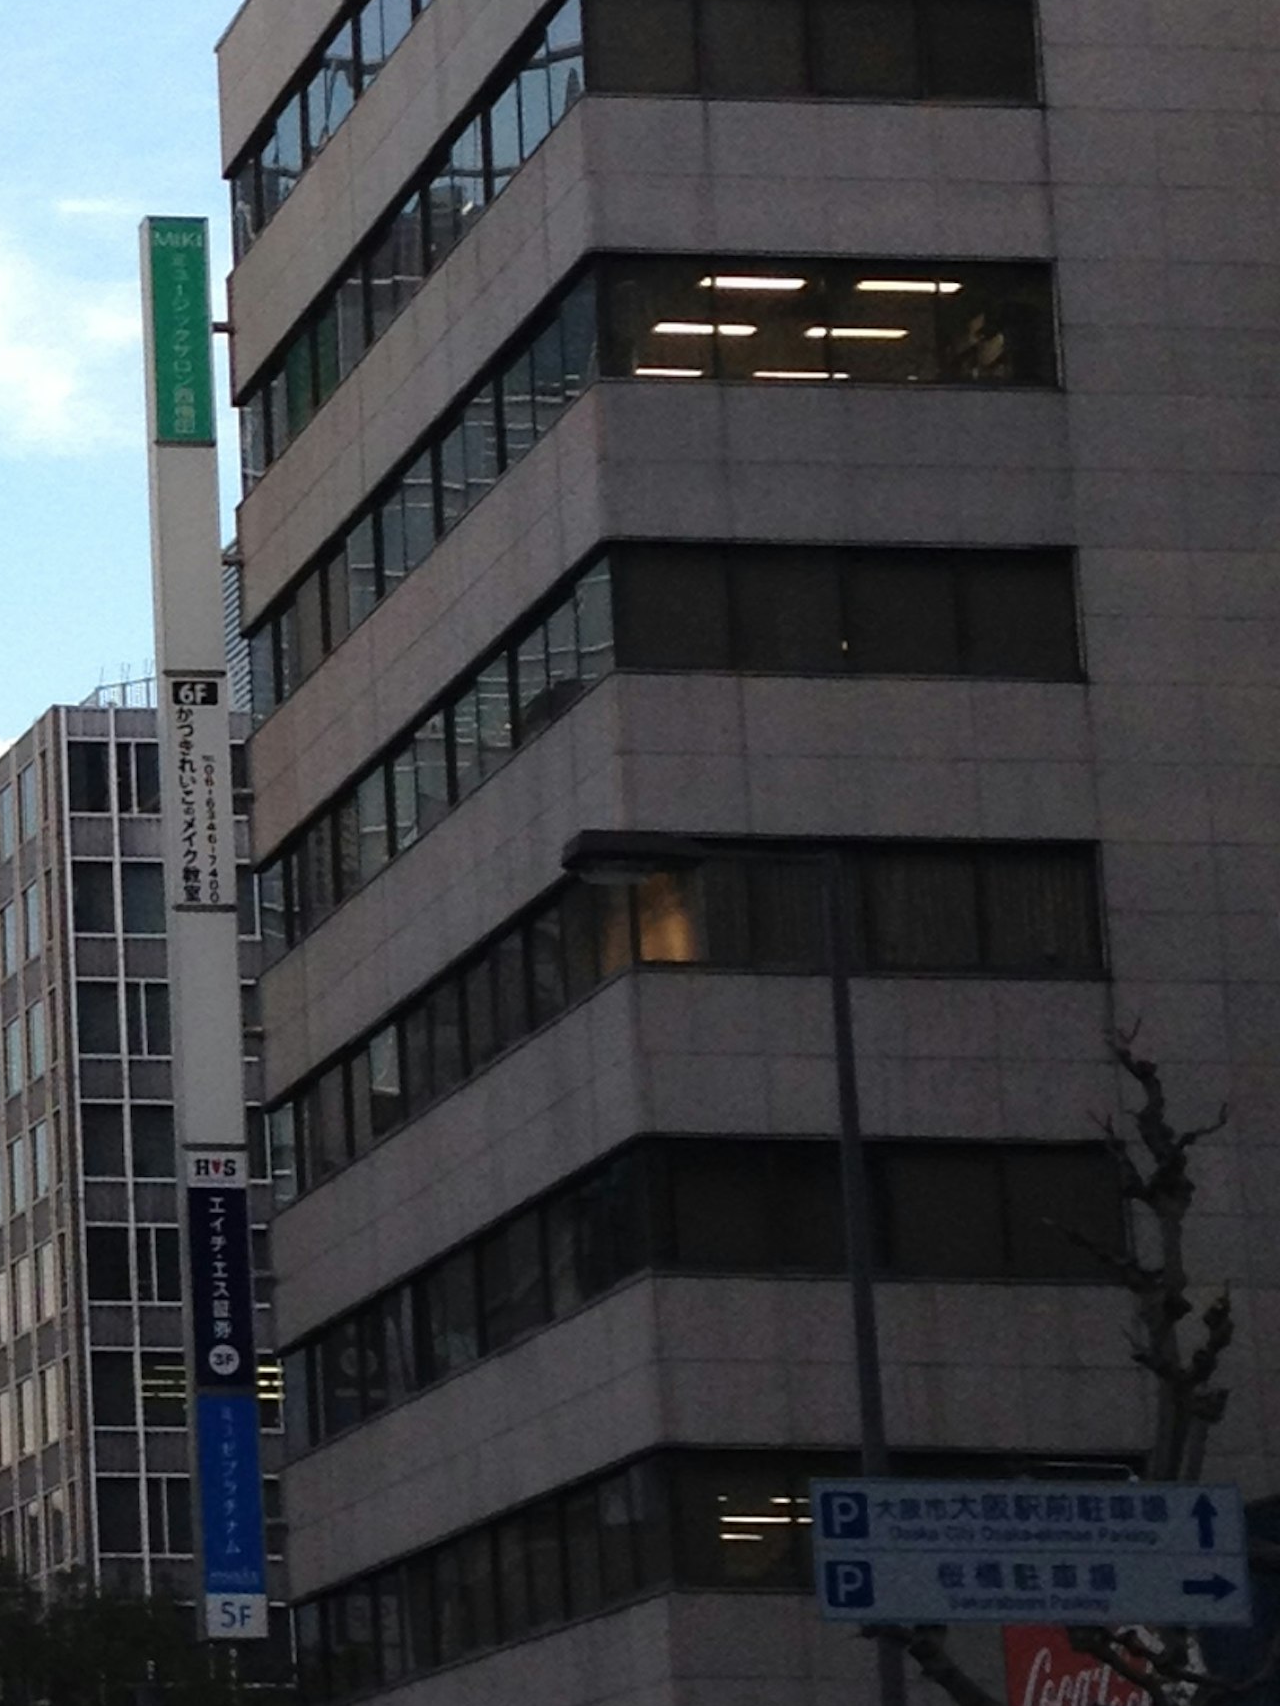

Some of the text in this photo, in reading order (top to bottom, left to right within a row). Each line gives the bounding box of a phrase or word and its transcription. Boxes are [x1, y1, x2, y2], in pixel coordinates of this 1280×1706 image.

[154, 231, 203, 248] MIKI
[178, 682, 209, 705] 6F
[214, 1353, 236, 1368] 3F
[221, 1600, 252, 1630] 5F
